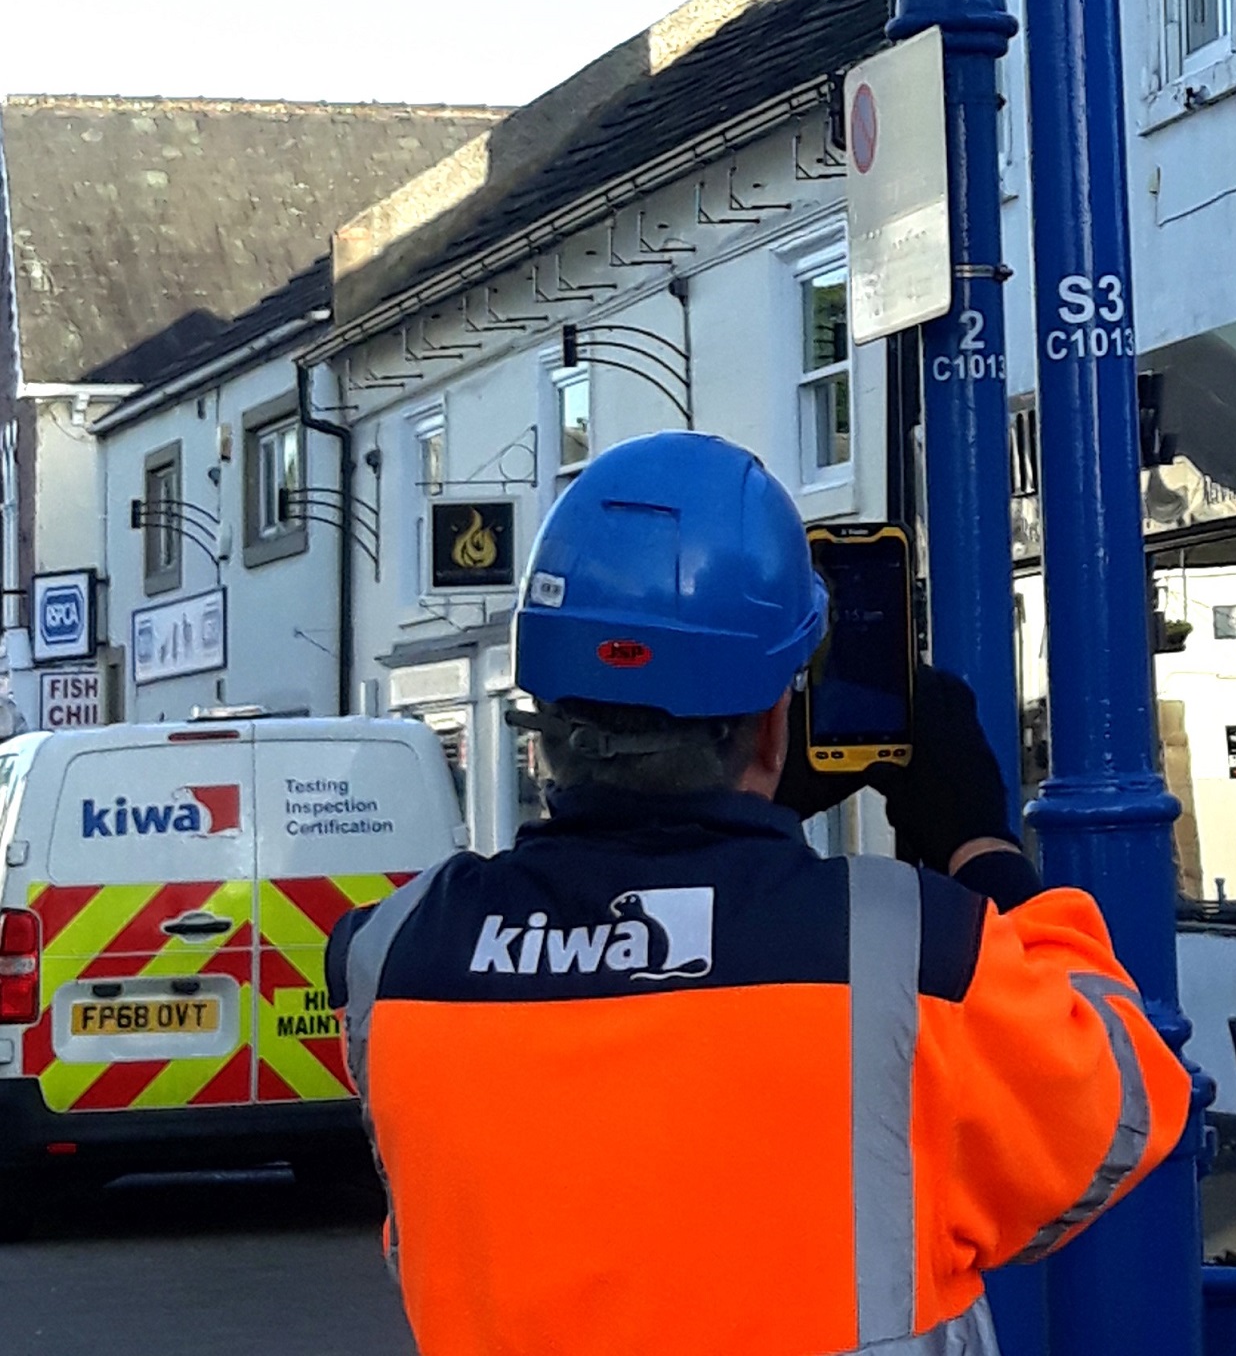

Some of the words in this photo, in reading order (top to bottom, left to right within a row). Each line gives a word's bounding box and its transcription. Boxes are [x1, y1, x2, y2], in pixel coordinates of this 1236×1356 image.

[1058, 274, 1125, 324] S3
[958, 310, 986, 350] 2
[1047, 328, 1135, 361] C1013
[49, 678, 98, 700] FISH
[285, 779, 349, 798] Testing
[81, 796, 202, 838] kiwa
[285, 799, 379, 816] Inspection
[285, 818, 394, 835] Certification
[469, 912, 650, 975] kiwa
[82, 1004, 149, 1030] FP68
[158, 1003, 208, 1028] OVT
